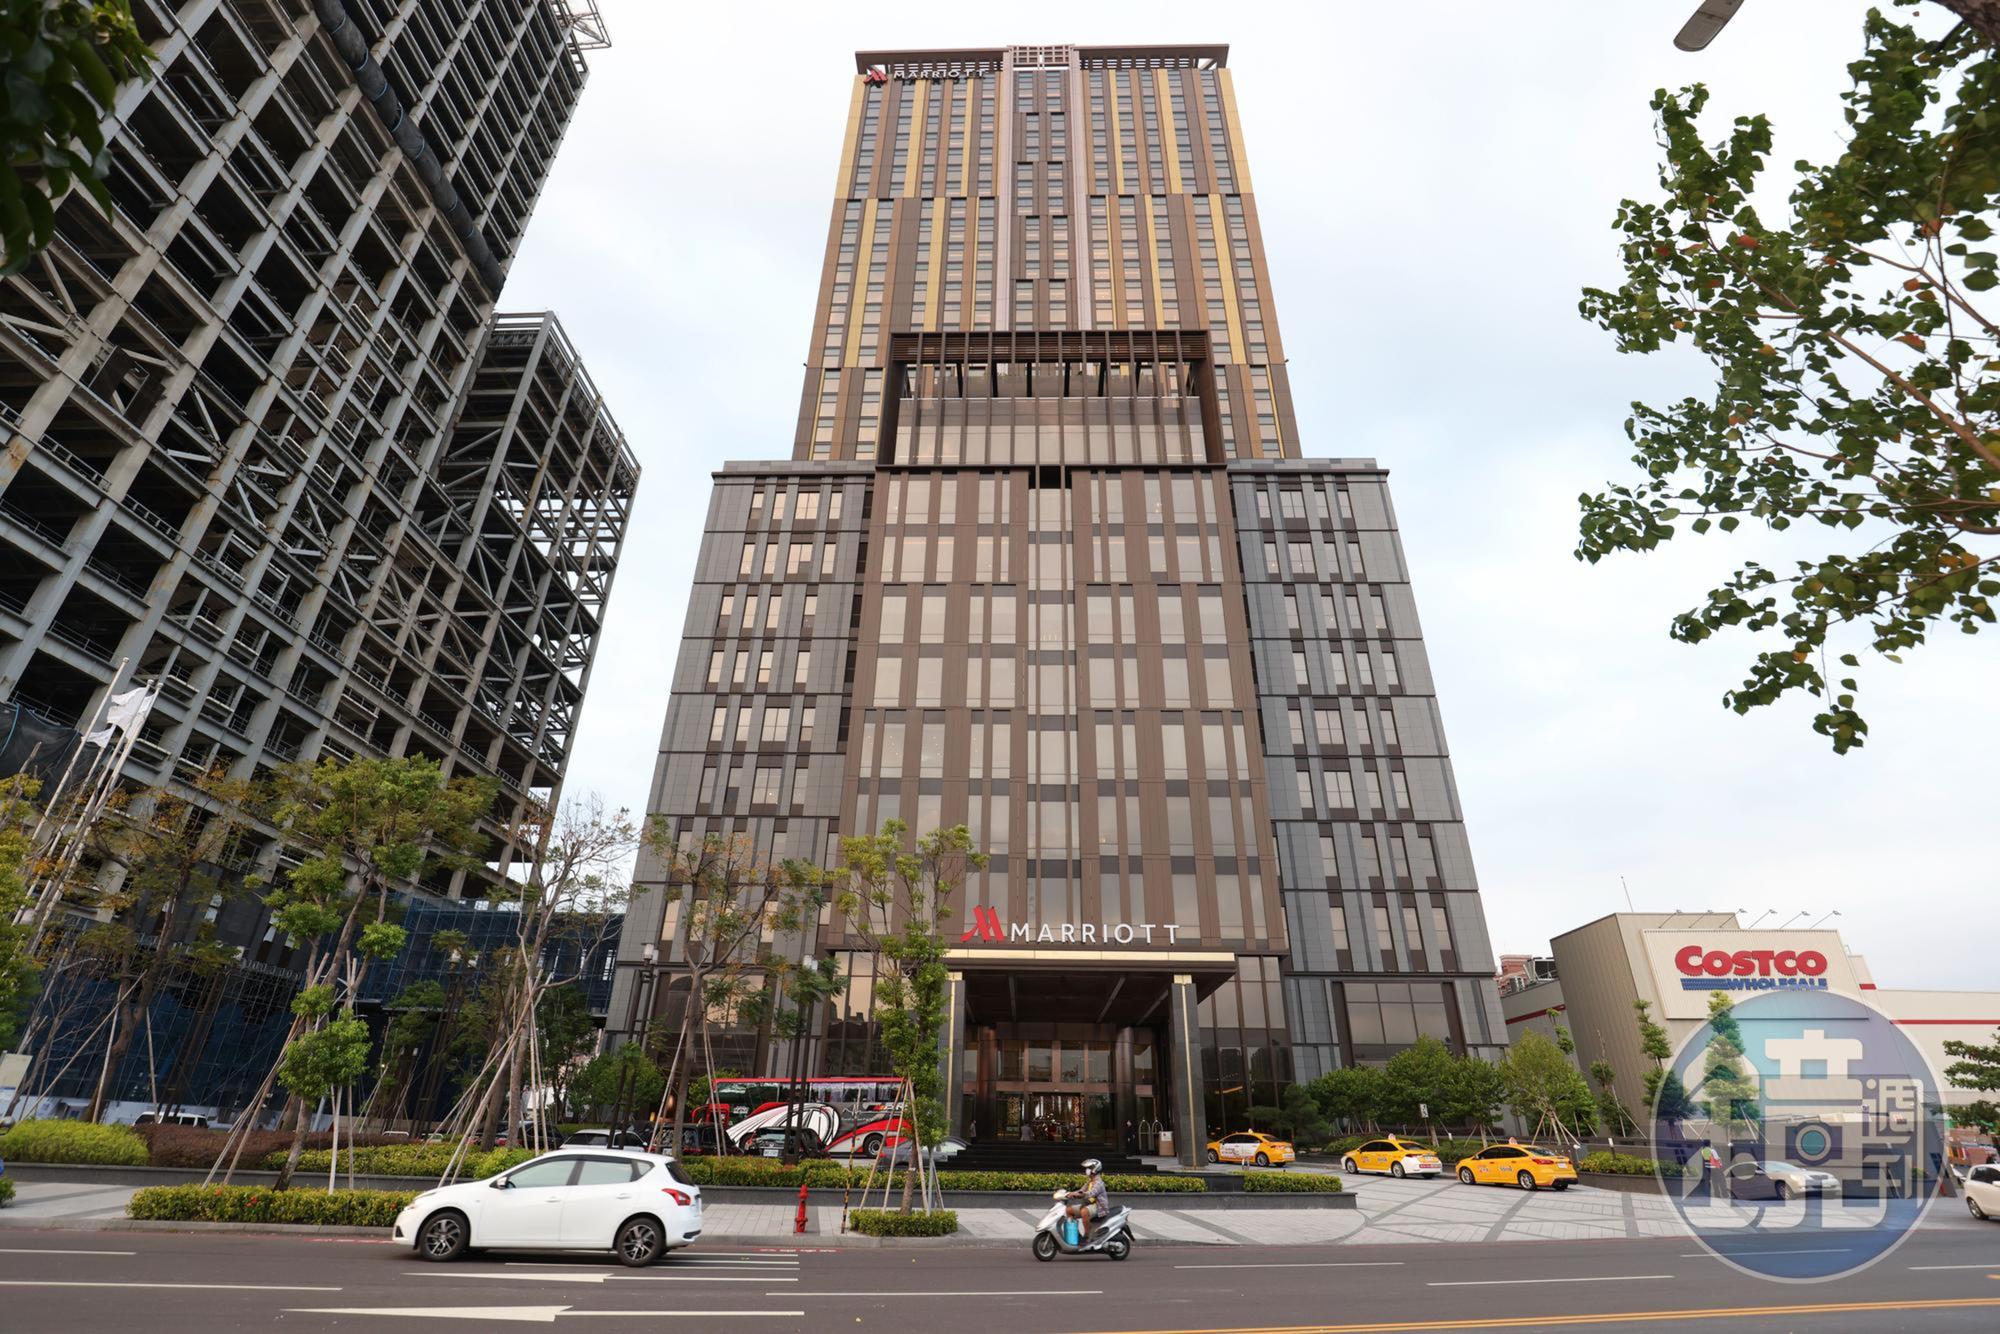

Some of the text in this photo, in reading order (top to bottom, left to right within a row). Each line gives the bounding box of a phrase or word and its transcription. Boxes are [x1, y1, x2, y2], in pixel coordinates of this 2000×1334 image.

[893, 69, 986, 79] MARRIOTT
[1011, 923, 1180, 944] MARRIOTT
[1675, 945, 1828, 977] COSTCO
[1725, 978, 1828, 991] WHOLESALE
